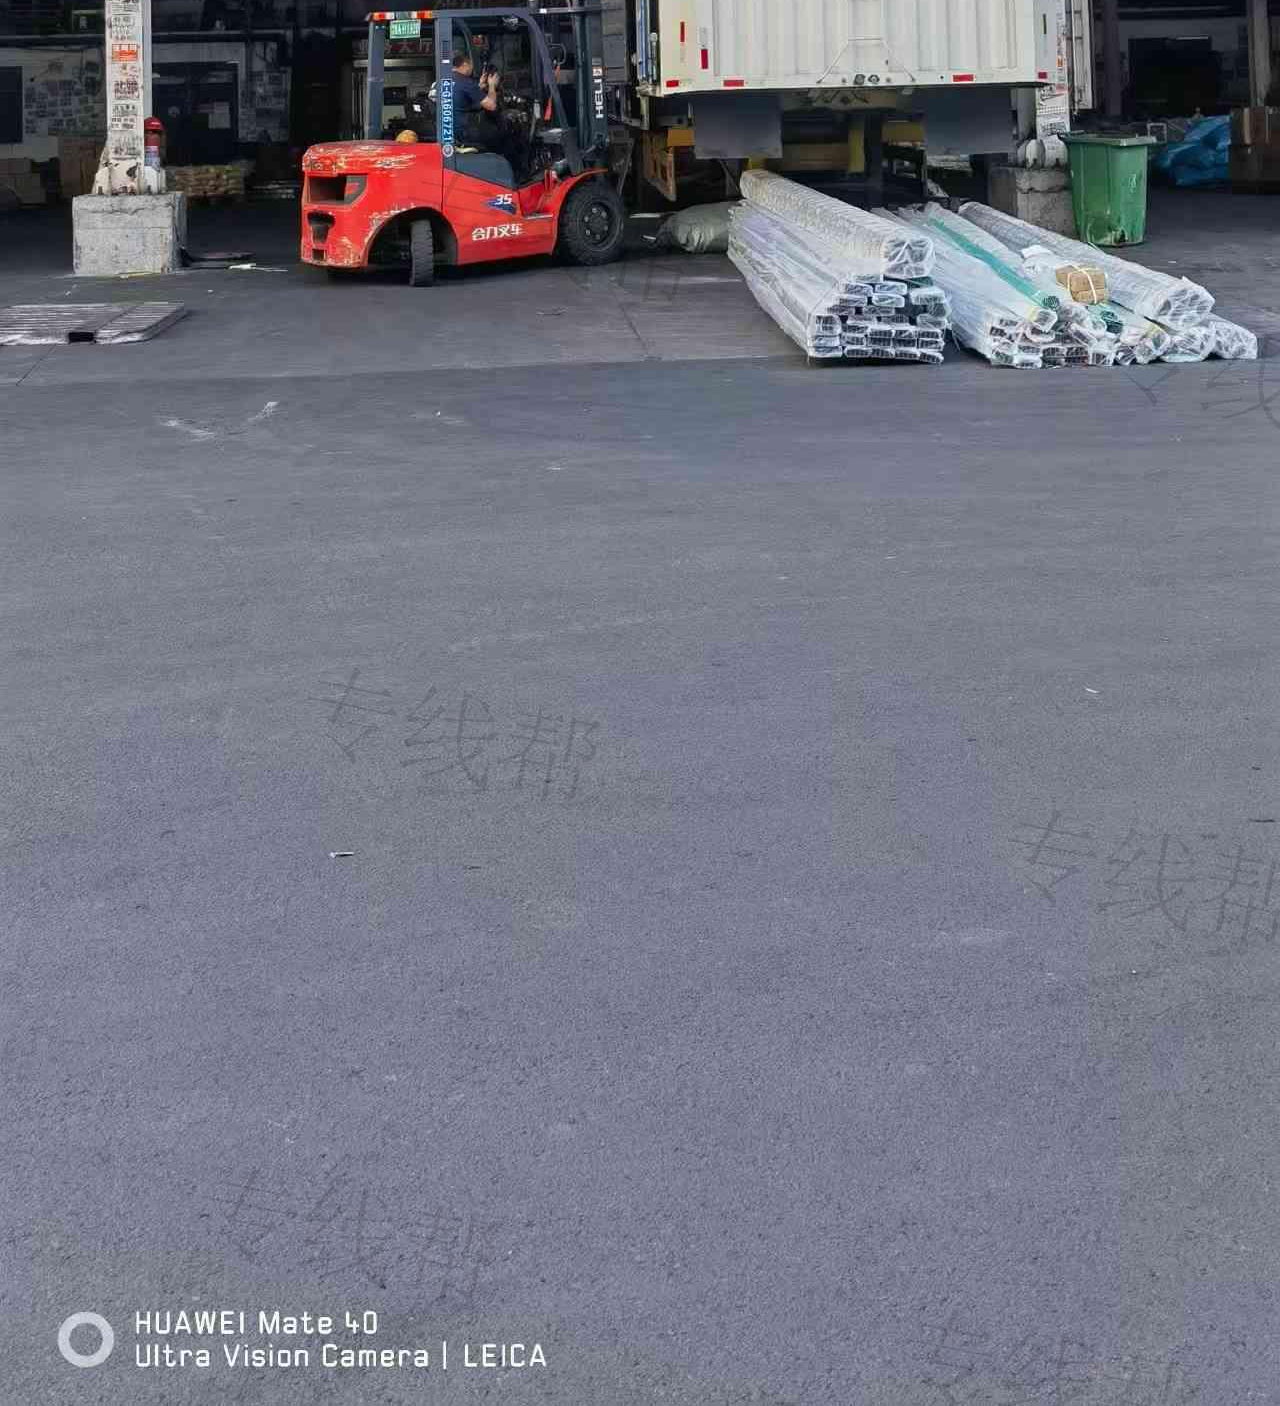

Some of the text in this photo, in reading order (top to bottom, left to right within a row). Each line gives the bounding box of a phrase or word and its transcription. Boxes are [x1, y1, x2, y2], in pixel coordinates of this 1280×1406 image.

[593, 78, 604, 119] HELI
[494, 193, 513, 205] 35
[471, 224, 522, 241] 合力叉车
